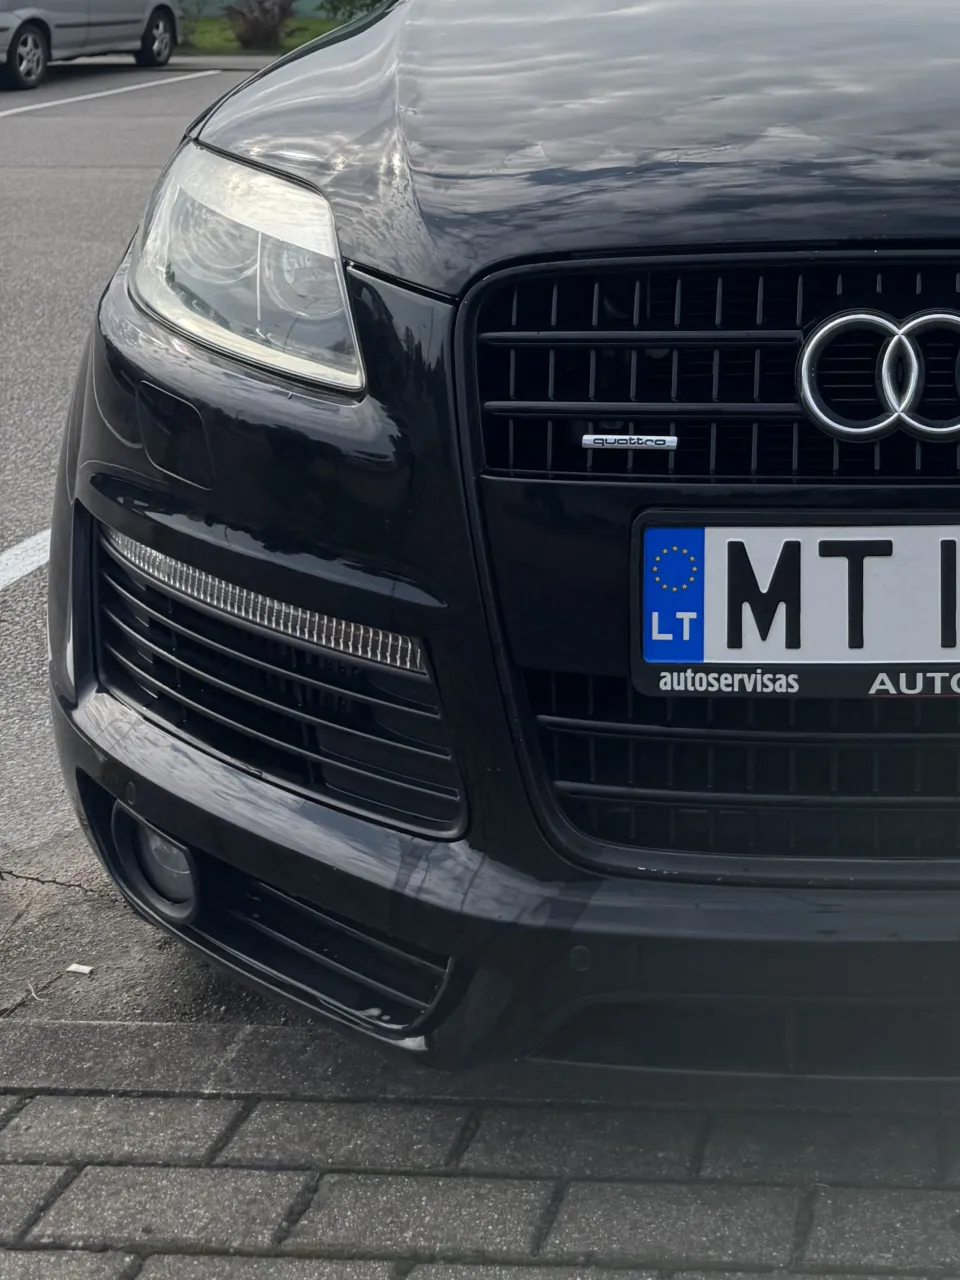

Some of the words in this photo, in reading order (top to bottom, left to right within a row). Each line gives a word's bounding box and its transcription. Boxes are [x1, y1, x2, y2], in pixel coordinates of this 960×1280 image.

[592, 437, 667, 447] quattro
[726, 539, 958, 650] MTI
[651, 611, 698, 641] LT
[658, 668, 800, 693] autoservisas
